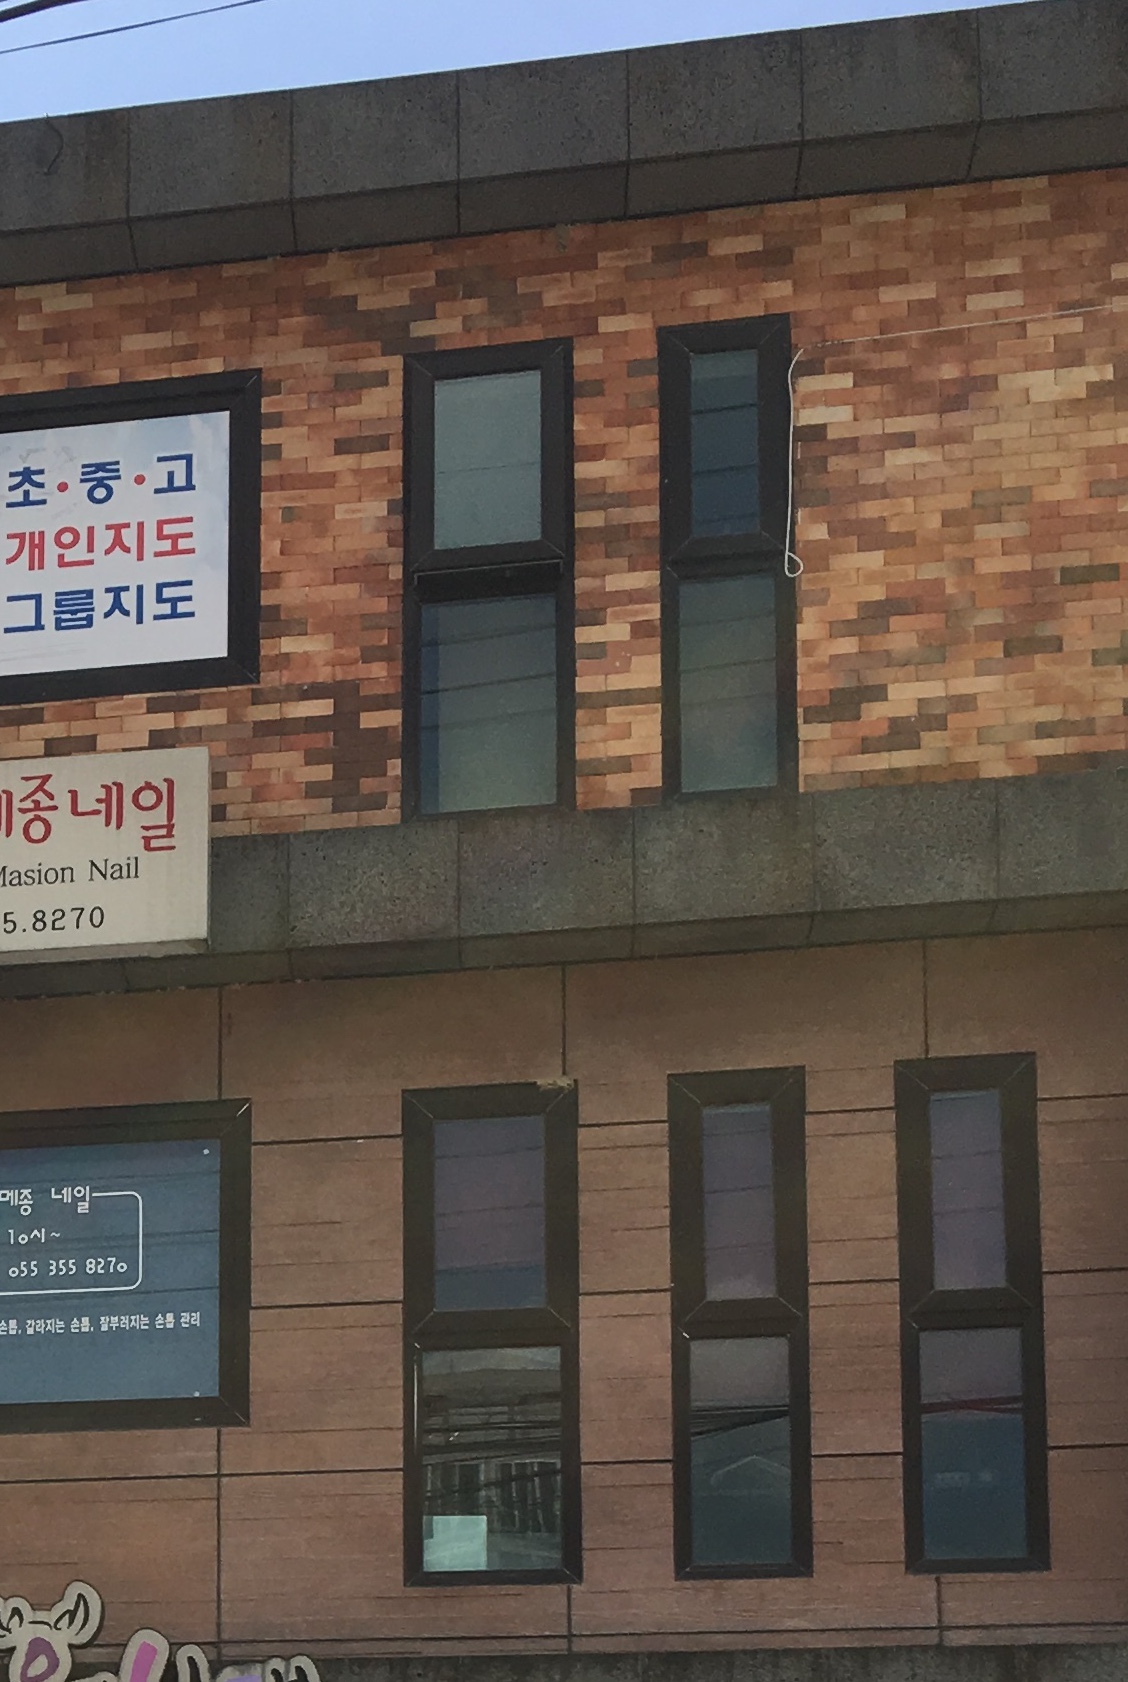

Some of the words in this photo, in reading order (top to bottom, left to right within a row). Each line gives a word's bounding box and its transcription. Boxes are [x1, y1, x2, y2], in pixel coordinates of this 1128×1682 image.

[5, 516, 196, 572] 개인지도
[3, 579, 196, 635] 그룹지도
[88, 856, 140, 882] Nail
[50, 1185, 91, 1214] 네일
[8, 1260, 38, 1278] 055
[48, 1258, 77, 1276] 355
[85, 1257, 128, 1275] 8270
[25, 1317, 66, 1335] 갈라지는
[180, 1311, 201, 1328] 관리
